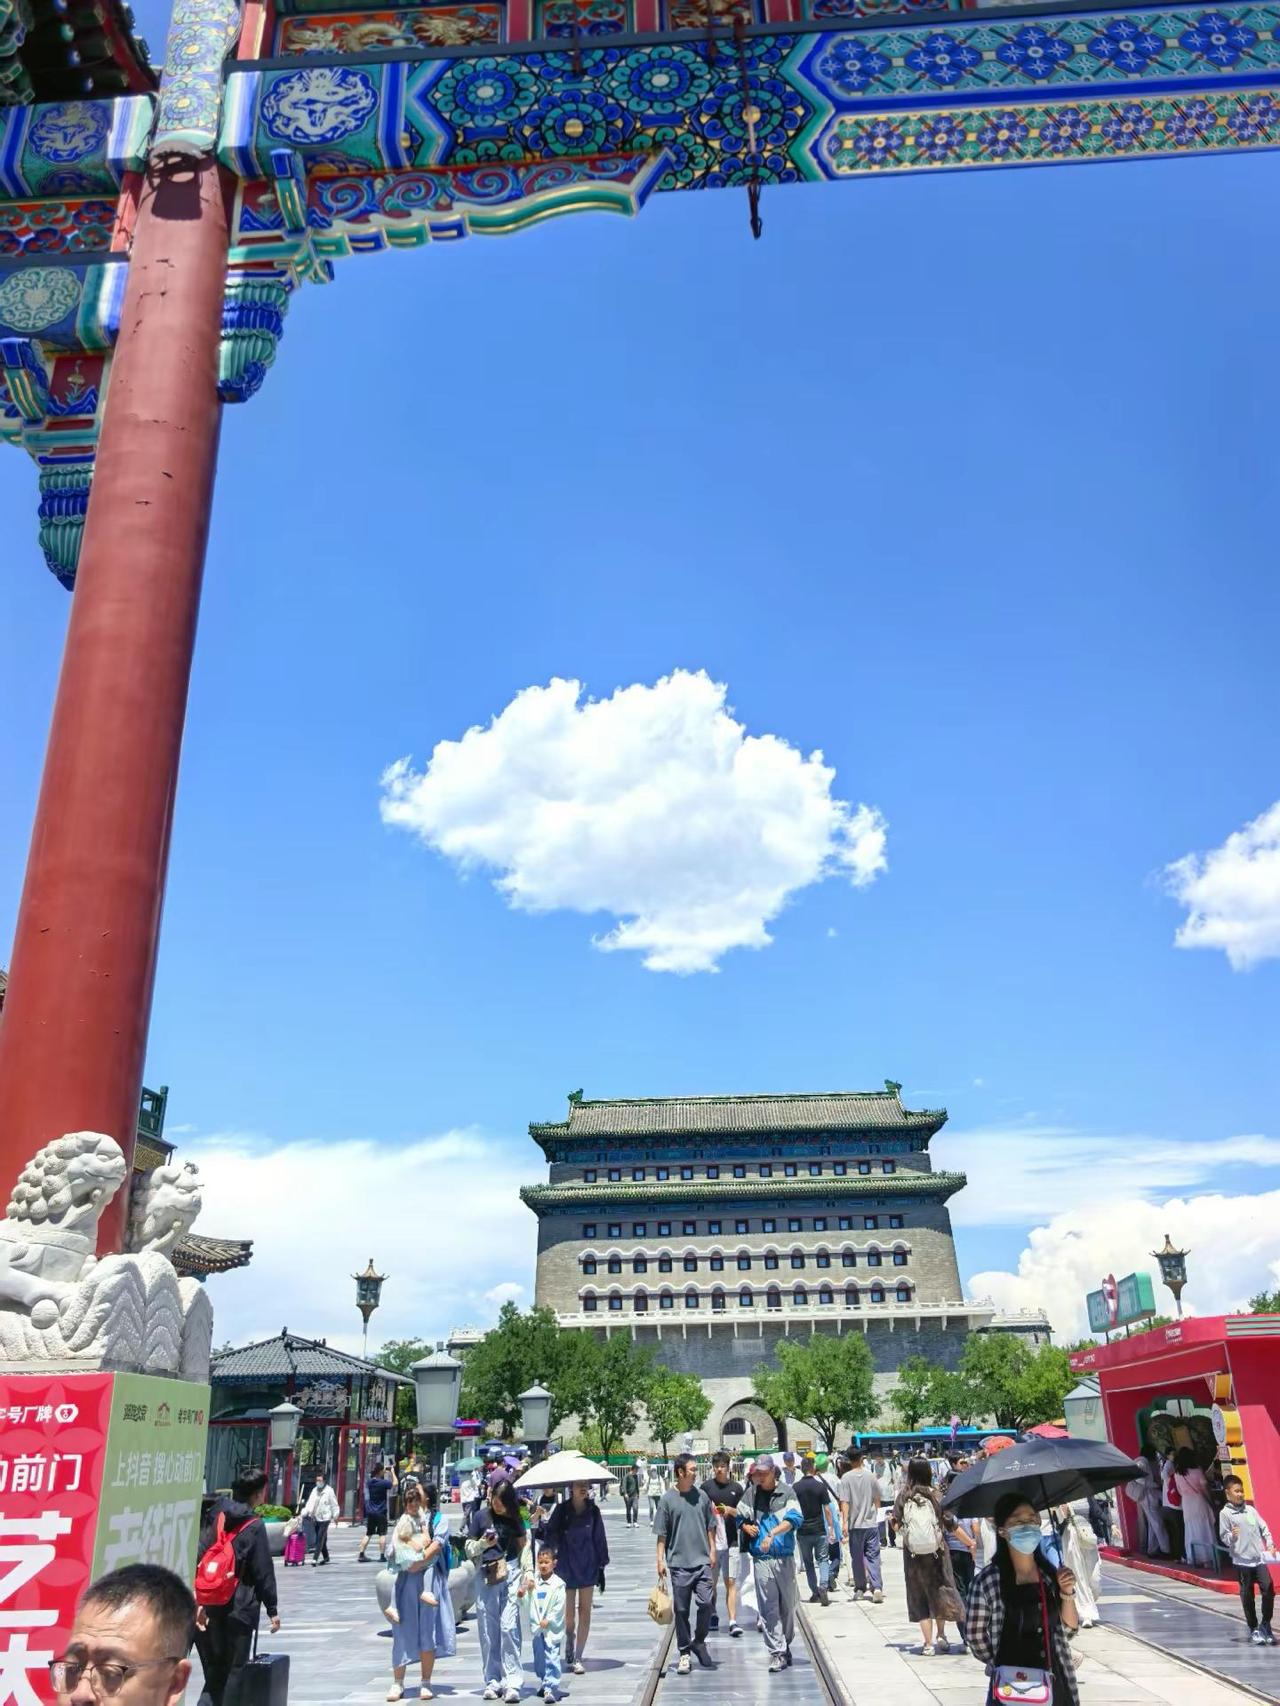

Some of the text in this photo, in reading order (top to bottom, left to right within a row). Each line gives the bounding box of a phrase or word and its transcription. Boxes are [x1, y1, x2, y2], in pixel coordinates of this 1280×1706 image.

[0, 1453, 82, 1493] 前门
[111, 1451, 151, 1487] 上抖音
